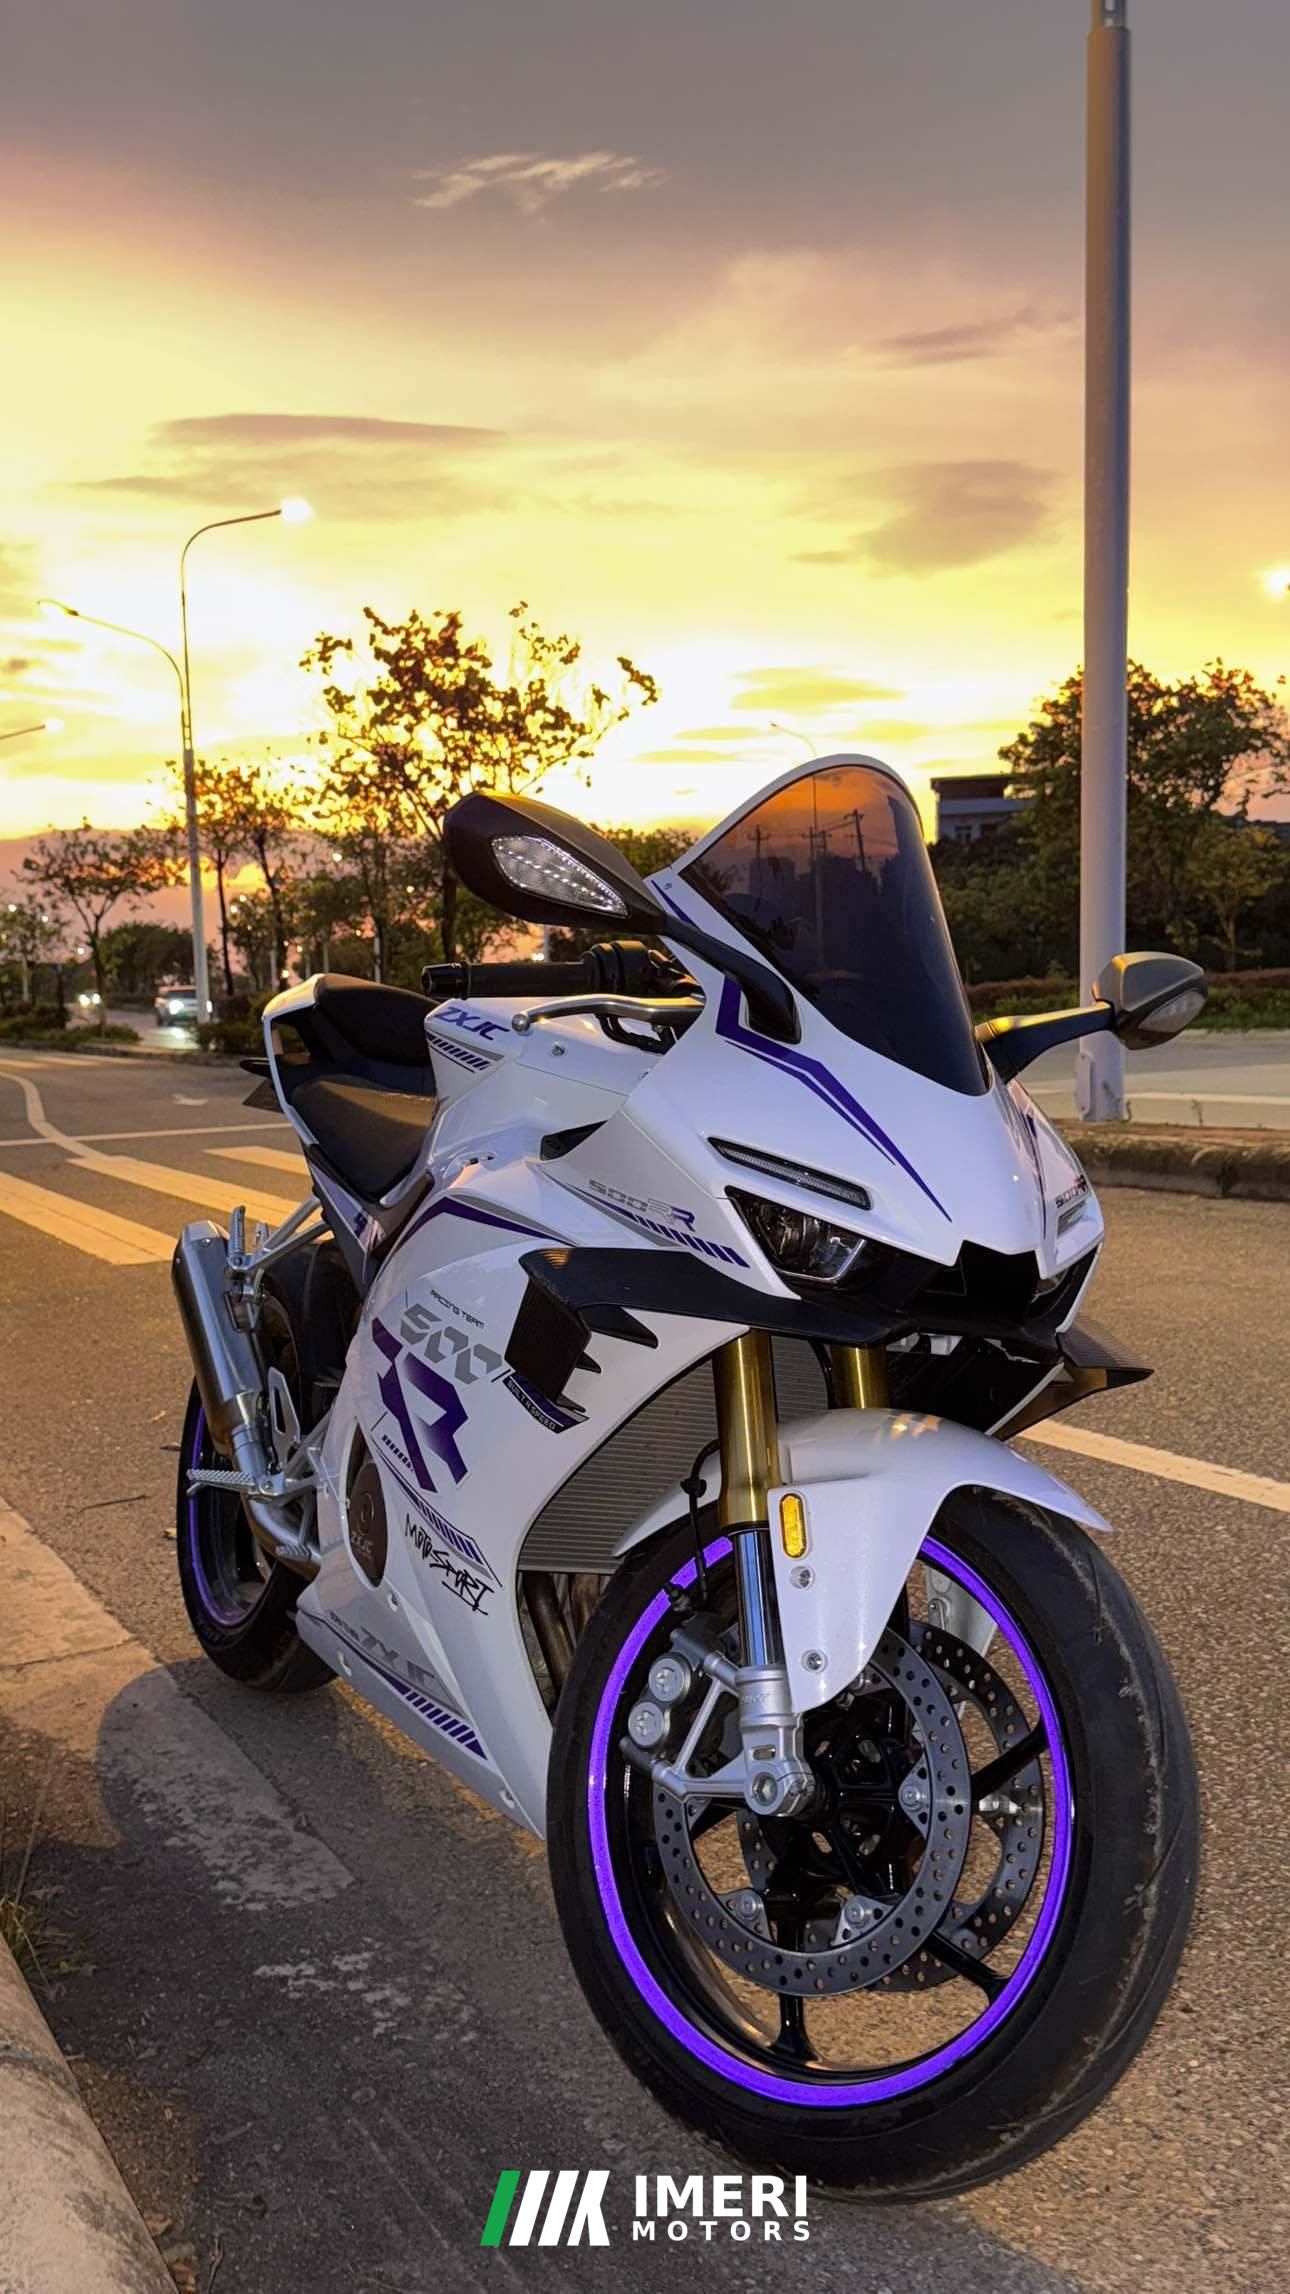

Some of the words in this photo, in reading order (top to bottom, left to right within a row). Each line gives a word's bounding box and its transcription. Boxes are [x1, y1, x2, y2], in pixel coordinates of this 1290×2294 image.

[400, 1303, 503, 1385] 500
[461, 1310, 484, 1330] TEAM
[506, 1379, 526, 1402] BUILT
[530, 1407, 556, 1430] SPEED
